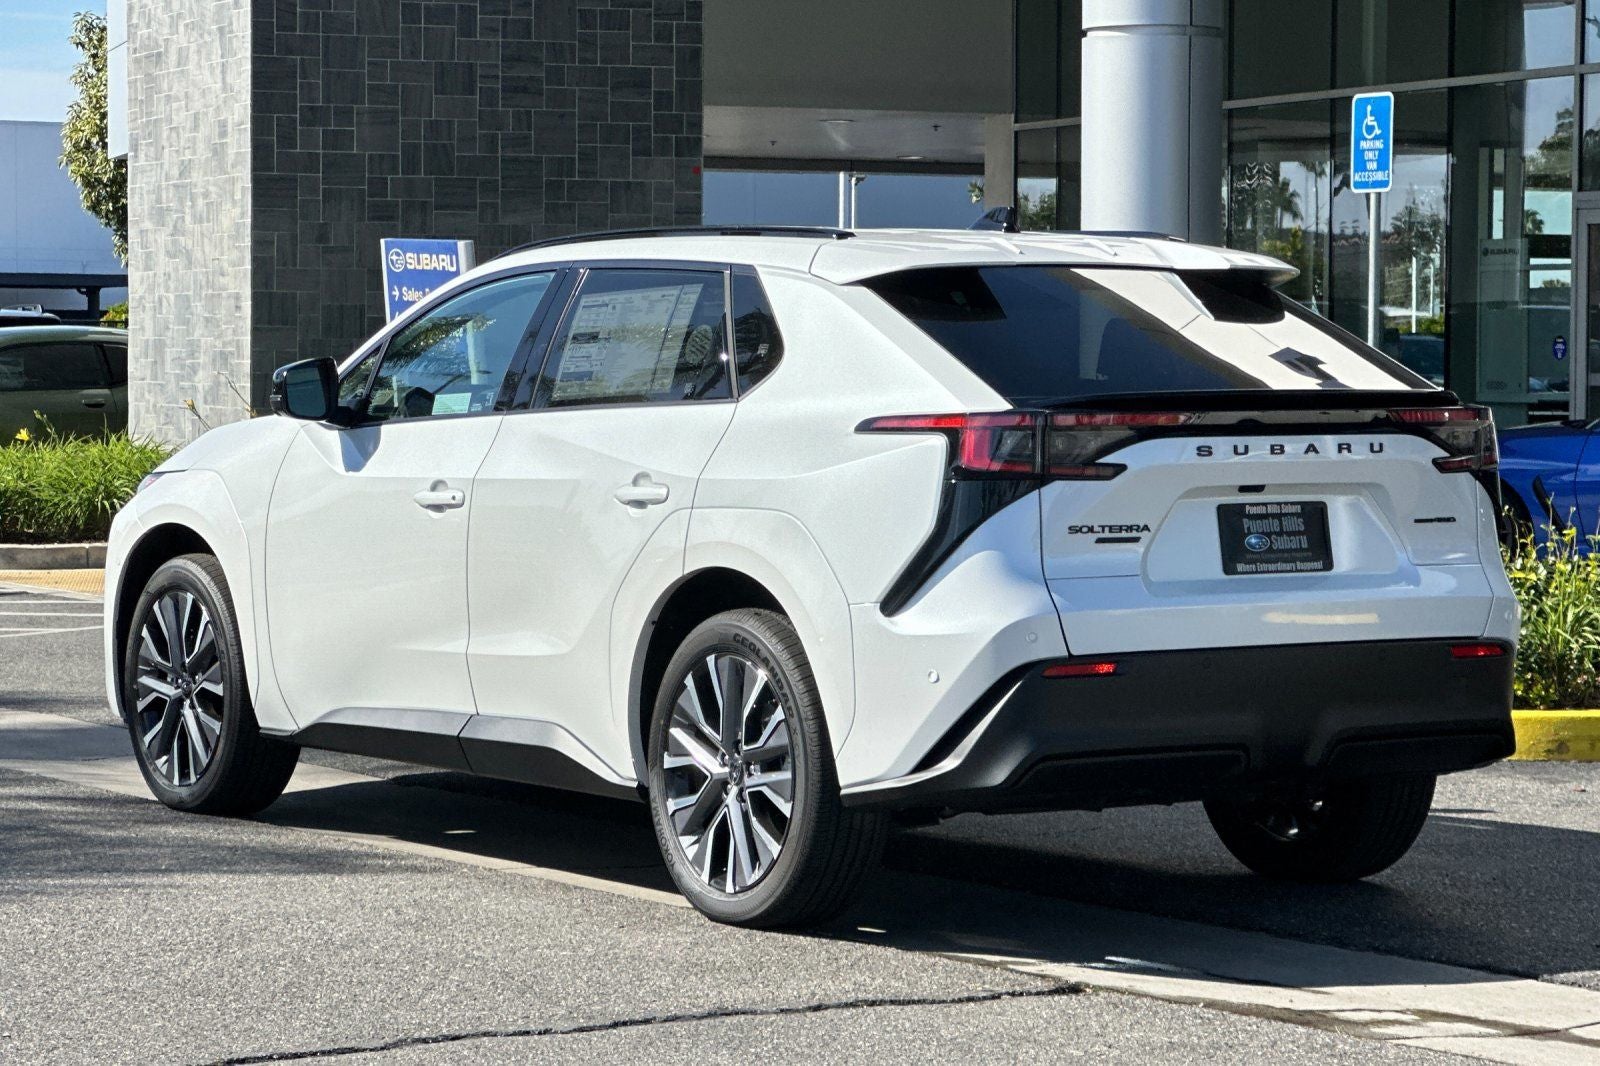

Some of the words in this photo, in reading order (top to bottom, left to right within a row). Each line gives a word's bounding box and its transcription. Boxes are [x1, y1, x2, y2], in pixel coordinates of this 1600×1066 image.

[1359, 139, 1384, 150] PARKING
[1364, 150, 1379, 160] ONLY
[1366, 160, 1378, 171] VAN
[1354, 171, 1389, 182] ACCESSIBLE
[405, 252, 457, 272] SUBARU
[402, 287, 423, 302] Sales
[1196, 442, 1384, 457] SUBARU
[1267, 504, 1281, 513] Hills
[1281, 503, 1302, 513] Subaru
[1067, 524, 1151, 535] SOLTERRA
[1243, 517, 1280, 533] Puente
[1282, 515, 1305, 532] Hills
[1271, 534, 1308, 550] Subaru
[1236, 562, 1256, 572] Where
[1256, 561, 1297, 572] Extraordinary
